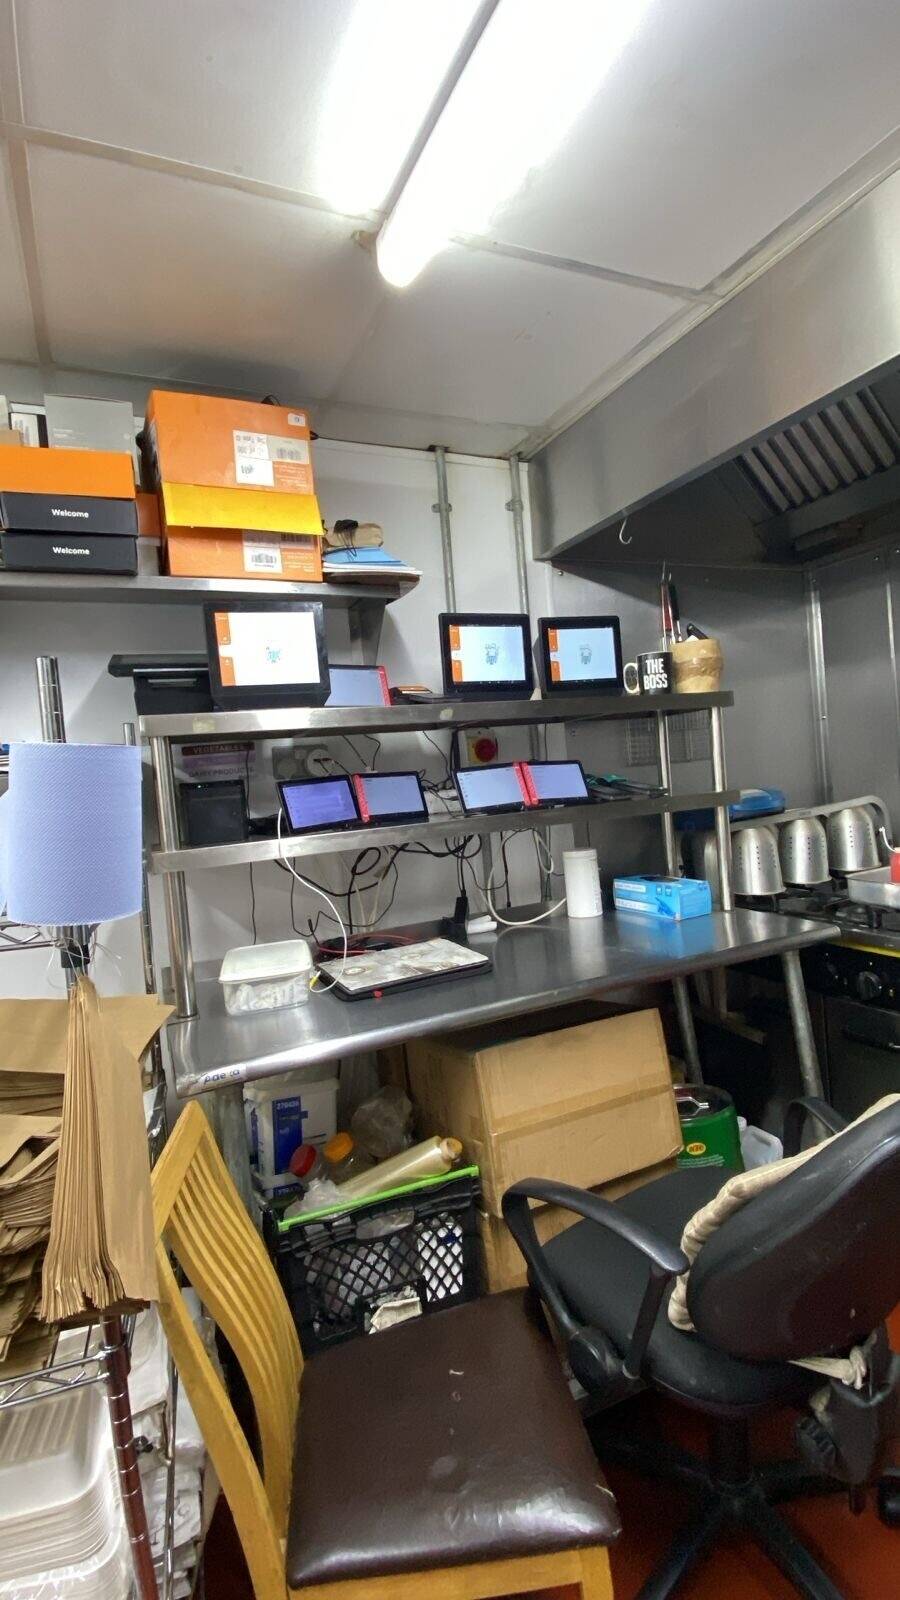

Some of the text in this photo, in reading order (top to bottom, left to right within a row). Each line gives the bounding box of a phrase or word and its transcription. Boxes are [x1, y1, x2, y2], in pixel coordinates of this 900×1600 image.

[51, 508, 89, 519] Welcome
[52, 546, 90, 556] Welcome
[646, 658, 664, 674] THE
[643, 673, 668, 690] BOSS
